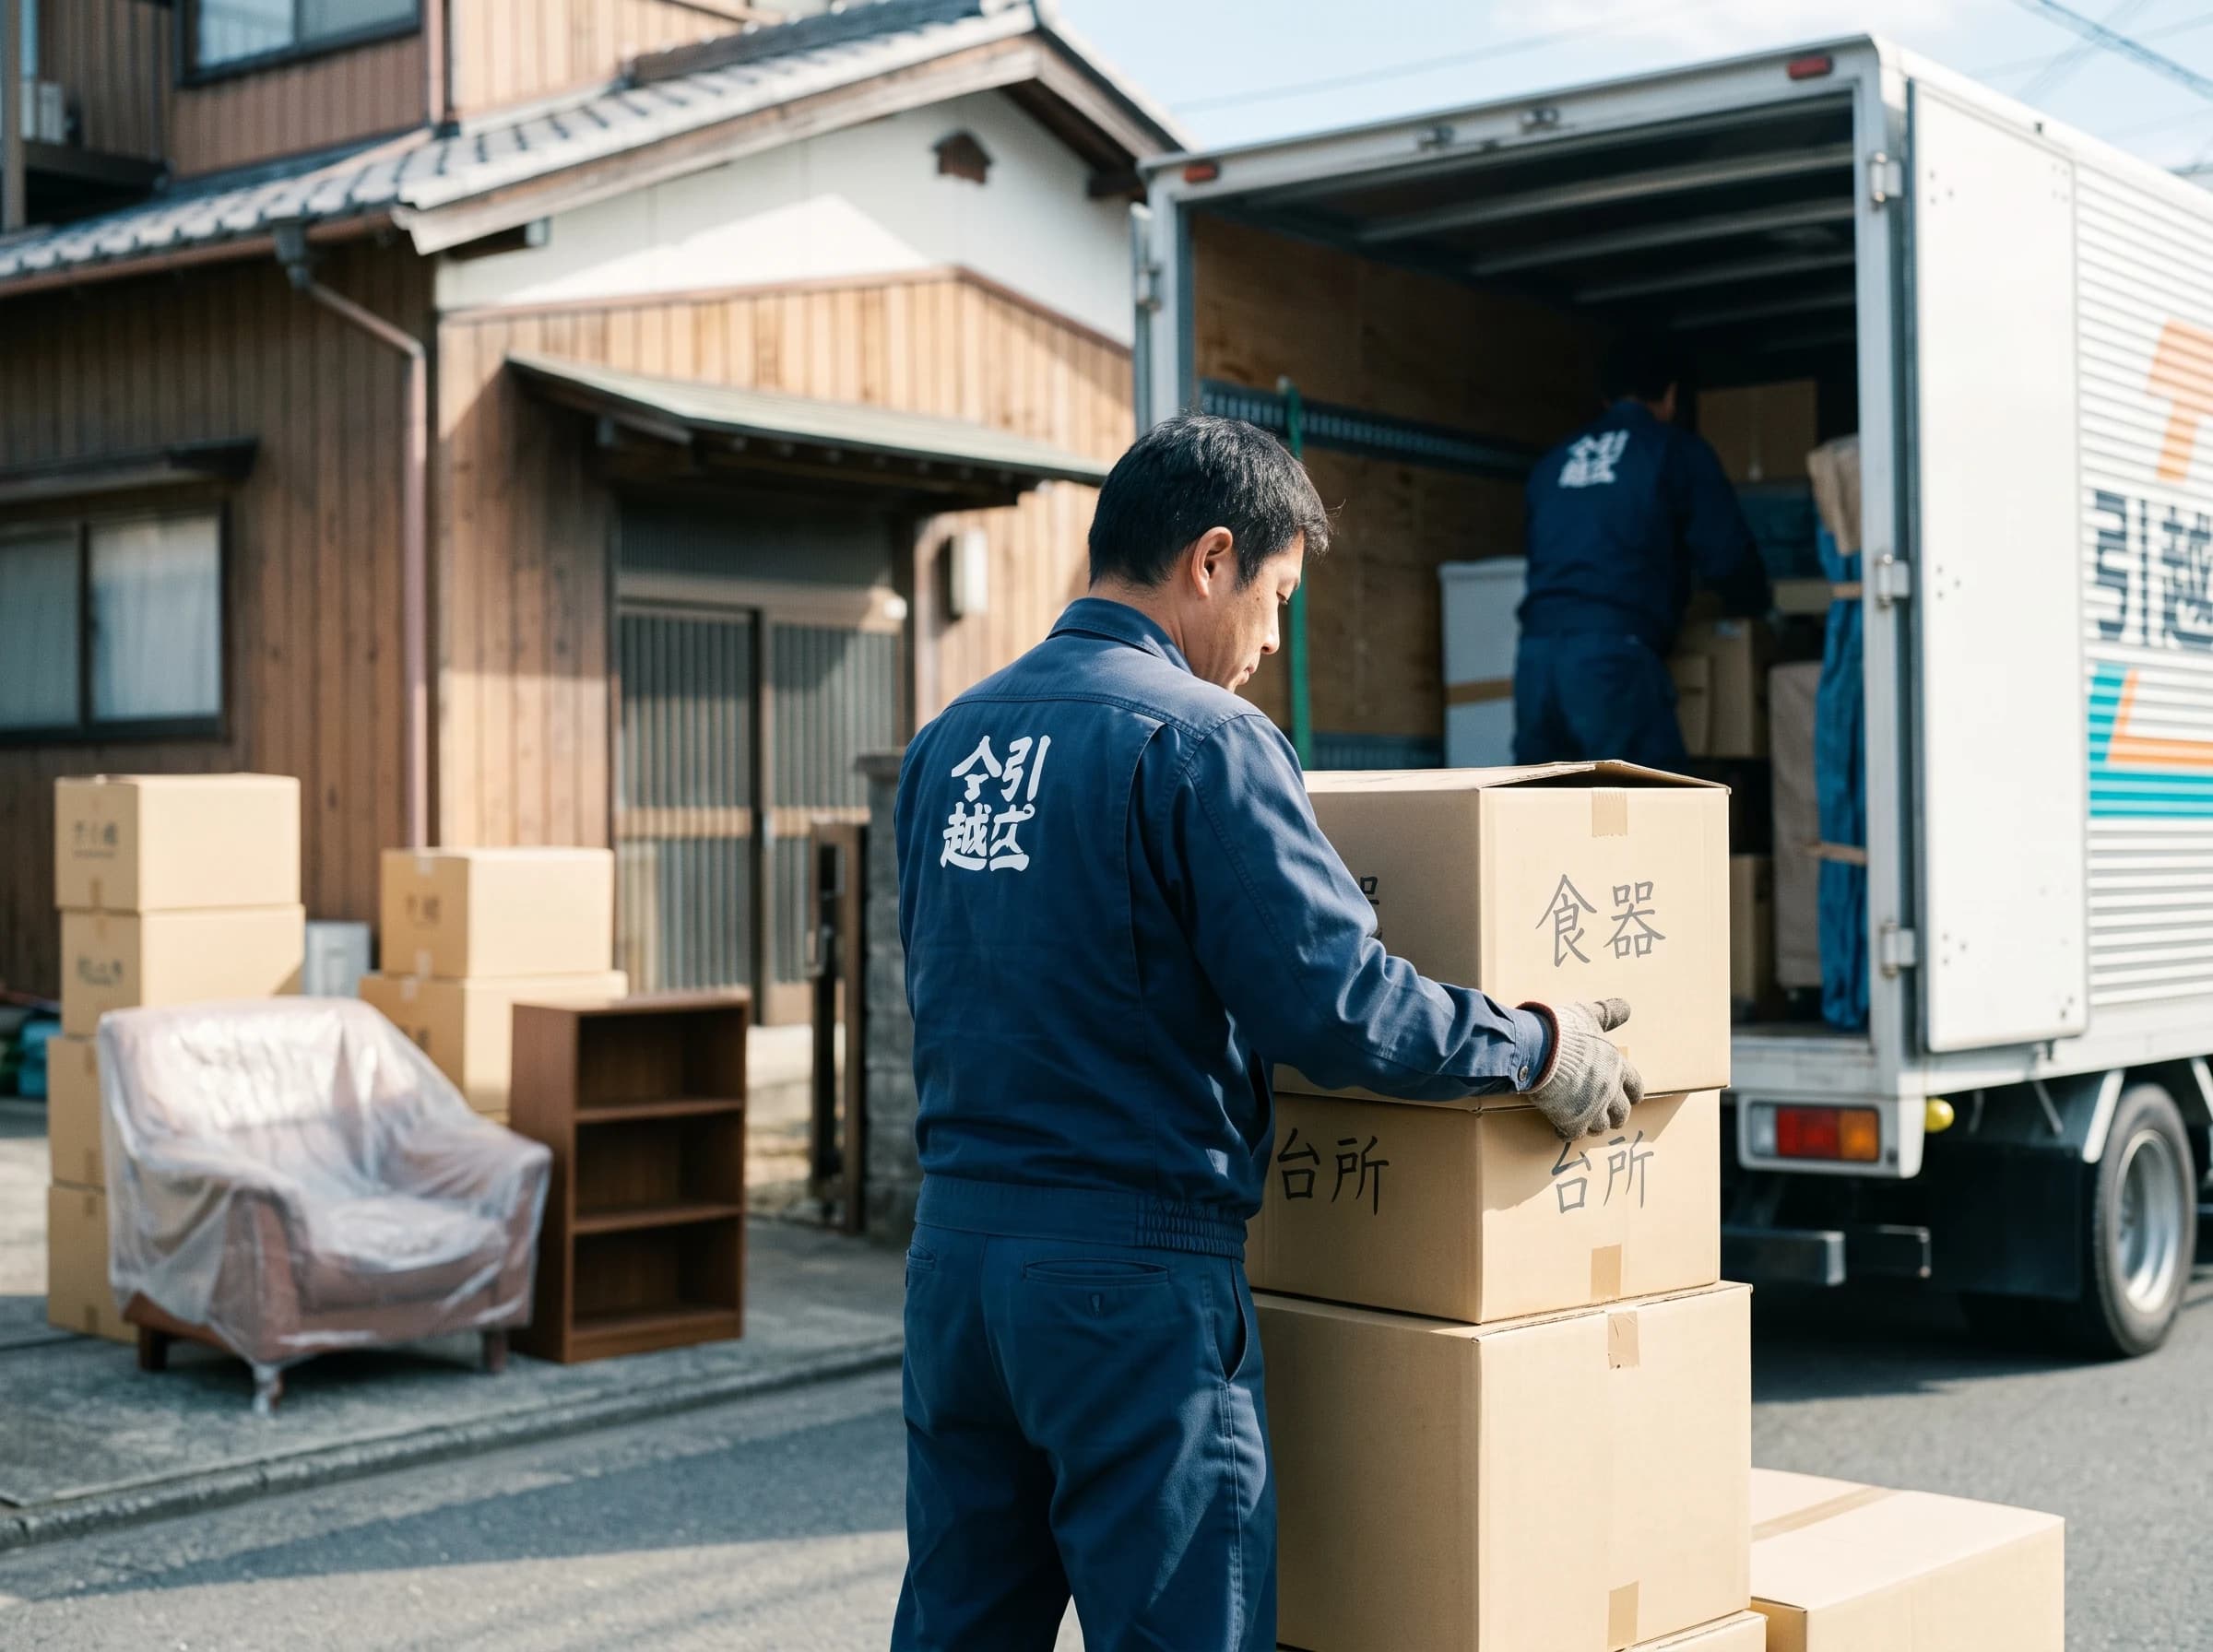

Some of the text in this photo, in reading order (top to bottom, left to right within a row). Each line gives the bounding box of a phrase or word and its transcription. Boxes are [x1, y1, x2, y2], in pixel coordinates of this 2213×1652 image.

[1534, 873, 1666, 968] 食器
[1276, 1127, 1390, 1216] 台所
[1551, 1129, 1654, 1214] 台所
